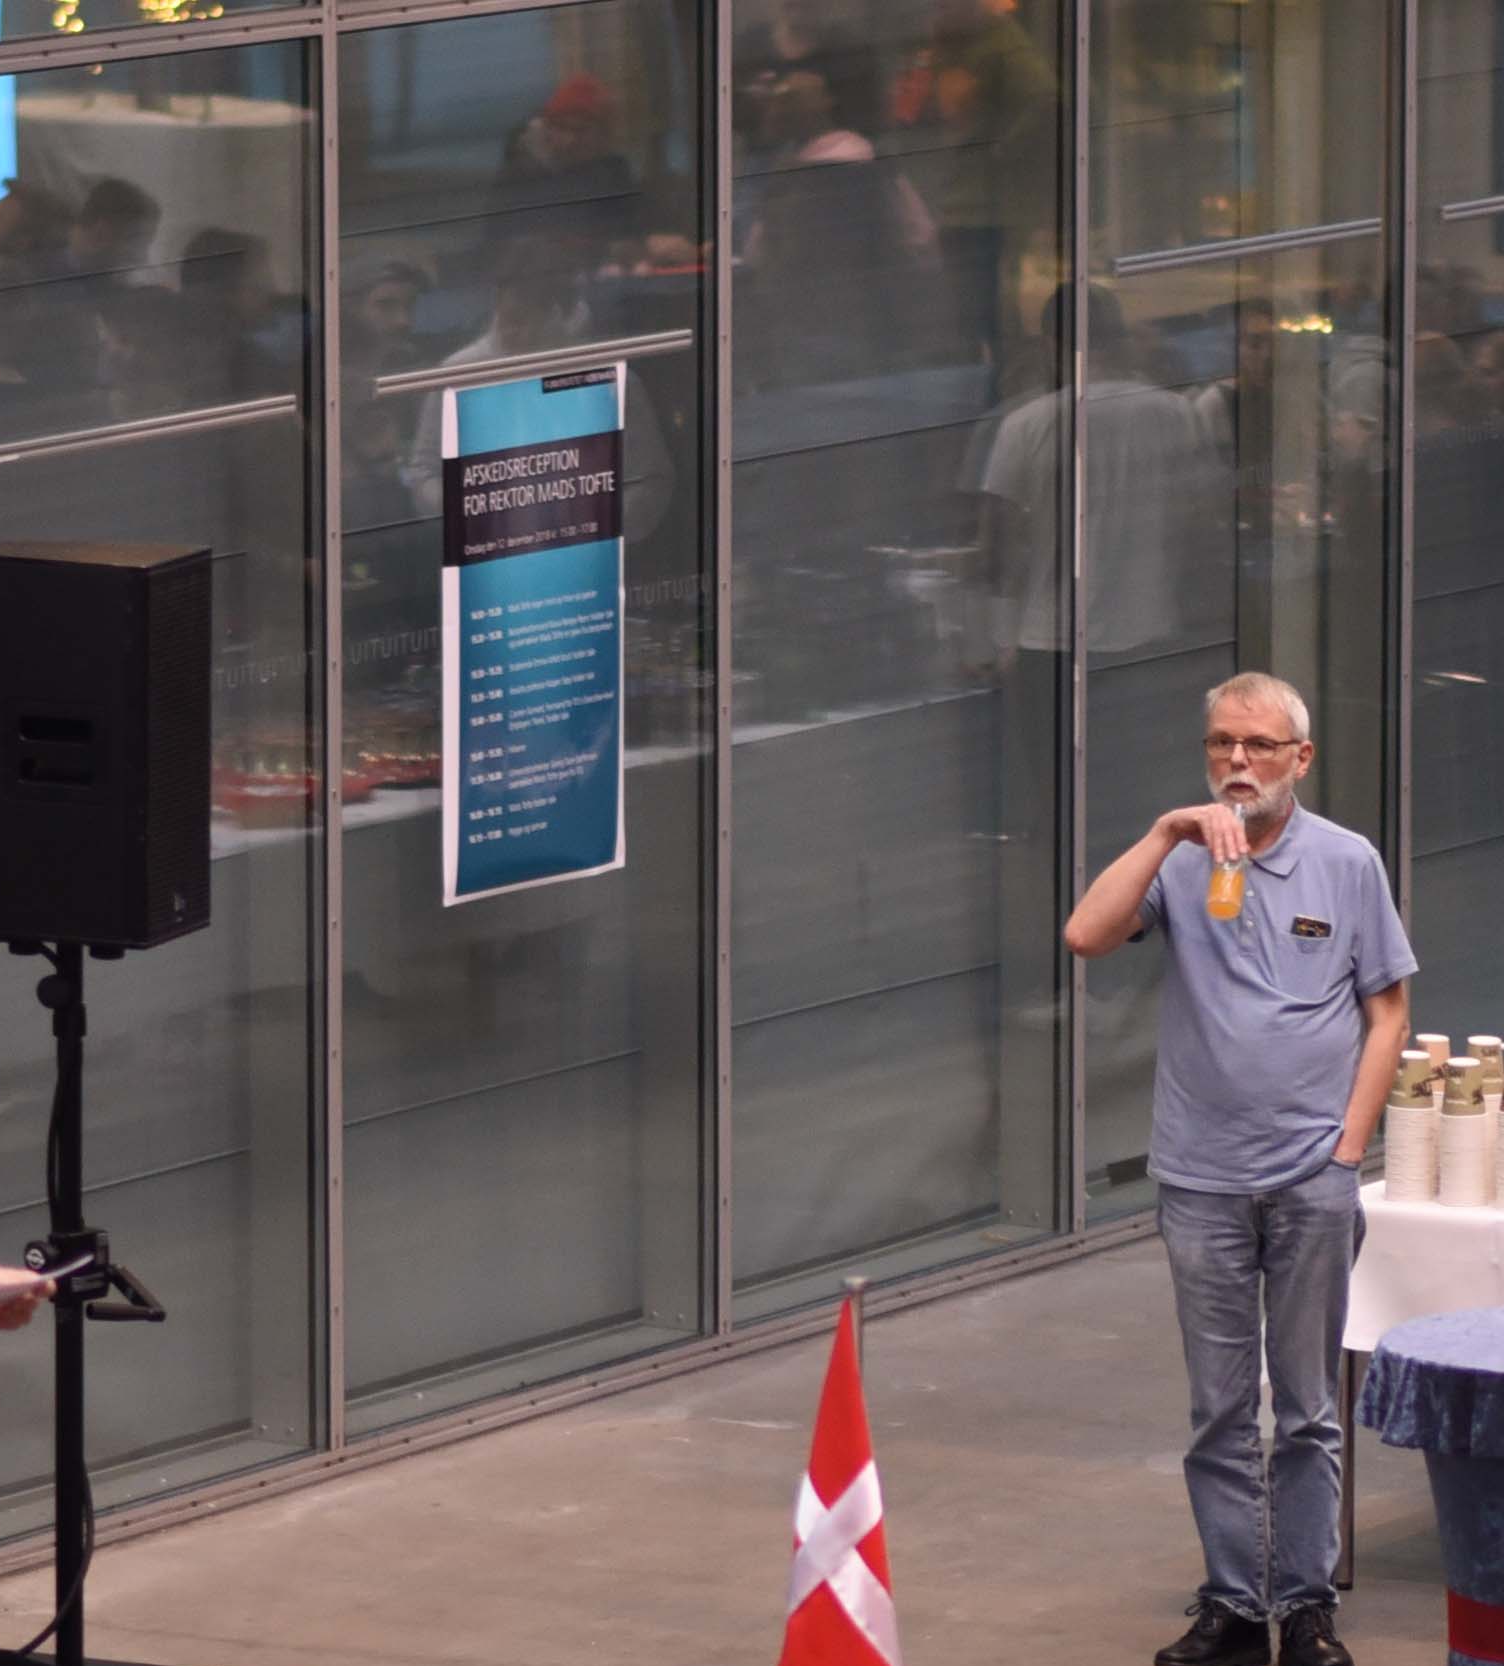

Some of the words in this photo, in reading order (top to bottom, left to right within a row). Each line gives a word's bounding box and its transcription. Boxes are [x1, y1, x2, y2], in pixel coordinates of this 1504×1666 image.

[463, 449, 580, 488] AFSKEDSRECEPTION
[464, 495, 488, 518] FOR
[489, 485, 535, 512] REKTOR
[537, 478, 576, 504] MADS
[578, 470, 616, 496] TOFTE
